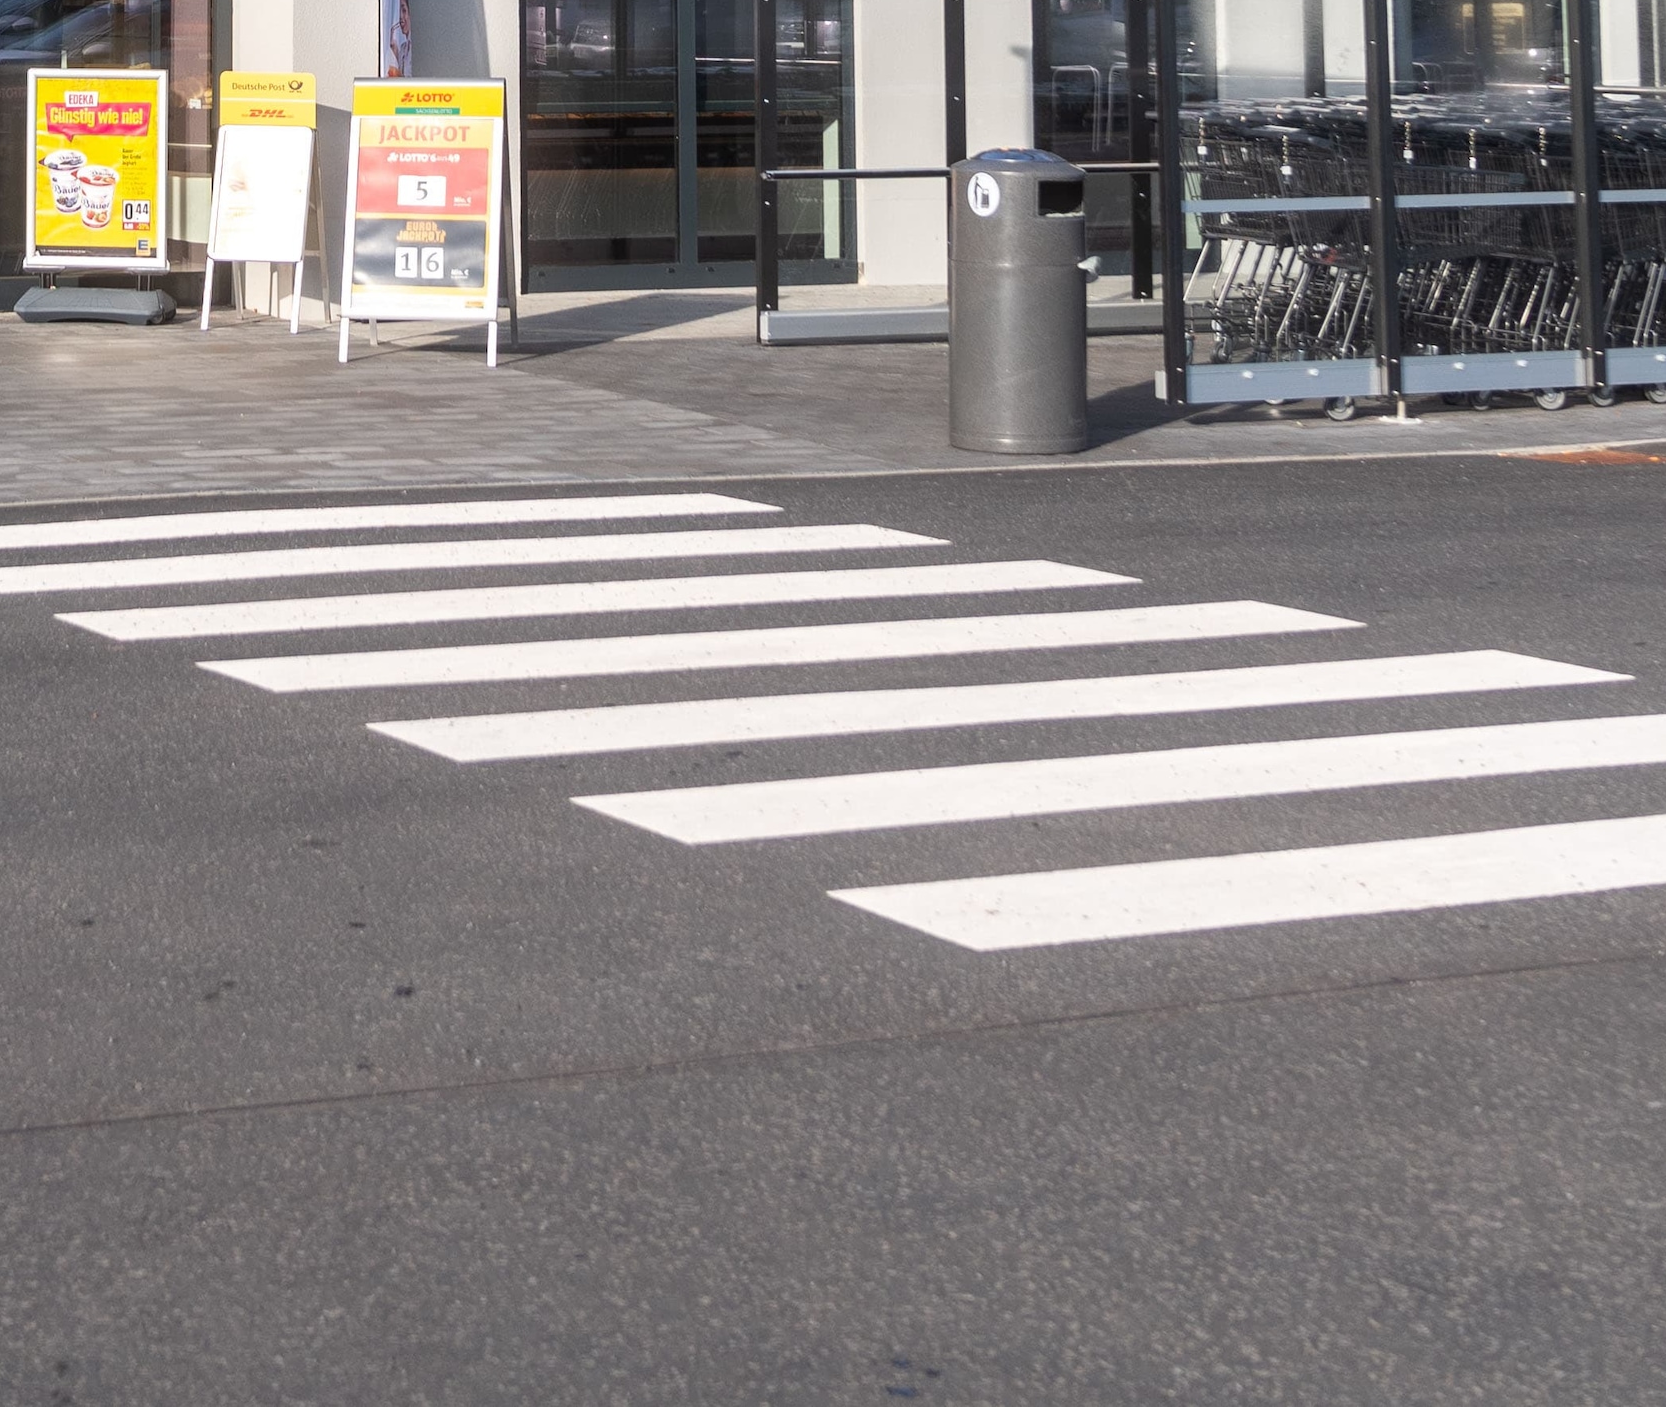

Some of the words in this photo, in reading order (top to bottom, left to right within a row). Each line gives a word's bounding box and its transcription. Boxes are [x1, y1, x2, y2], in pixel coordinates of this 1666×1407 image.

[232, 82, 267, 91] Deutsche
[269, 83, 285, 91] Post
[68, 94, 94, 105] EDEKA
[416, 93, 453, 103] LOTTO
[50, 107, 95, 128] Günstig
[98, 108, 118, 124] wie
[121, 107, 143, 124] nie!
[249, 109, 286, 118] DHL
[378, 125, 471, 145] JACKPOT
[399, 153, 429, 163] LOTTO
[416, 181, 428, 201] 5
[396, 230, 441, 243] JACKPOT
